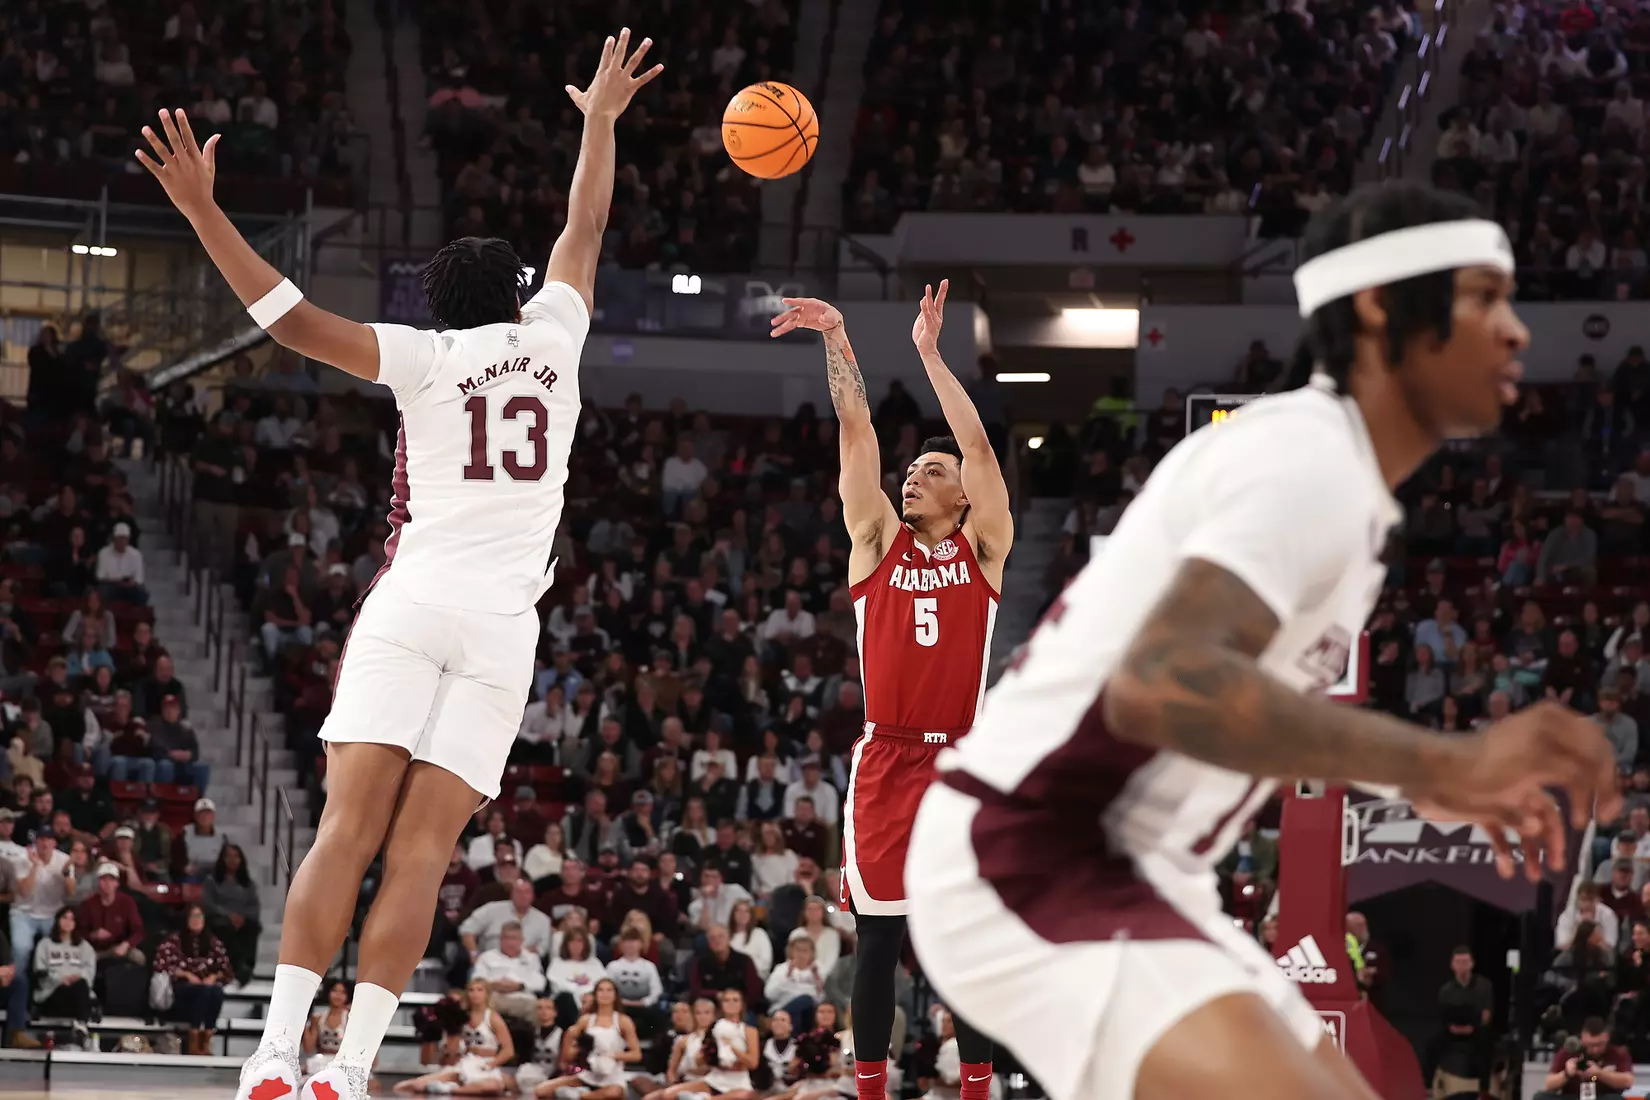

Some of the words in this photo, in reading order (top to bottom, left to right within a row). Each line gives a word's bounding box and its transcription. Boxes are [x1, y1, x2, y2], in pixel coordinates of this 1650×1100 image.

[457, 357, 531, 395] McNAIR
[533, 365, 558, 393] JR.
[462, 394, 549, 483] 13
[936, 541, 954, 556] SEC
[889, 561, 971, 592] ALABAMA
[914, 598, 939, 647] 5
[923, 732, 947, 743] RTR
